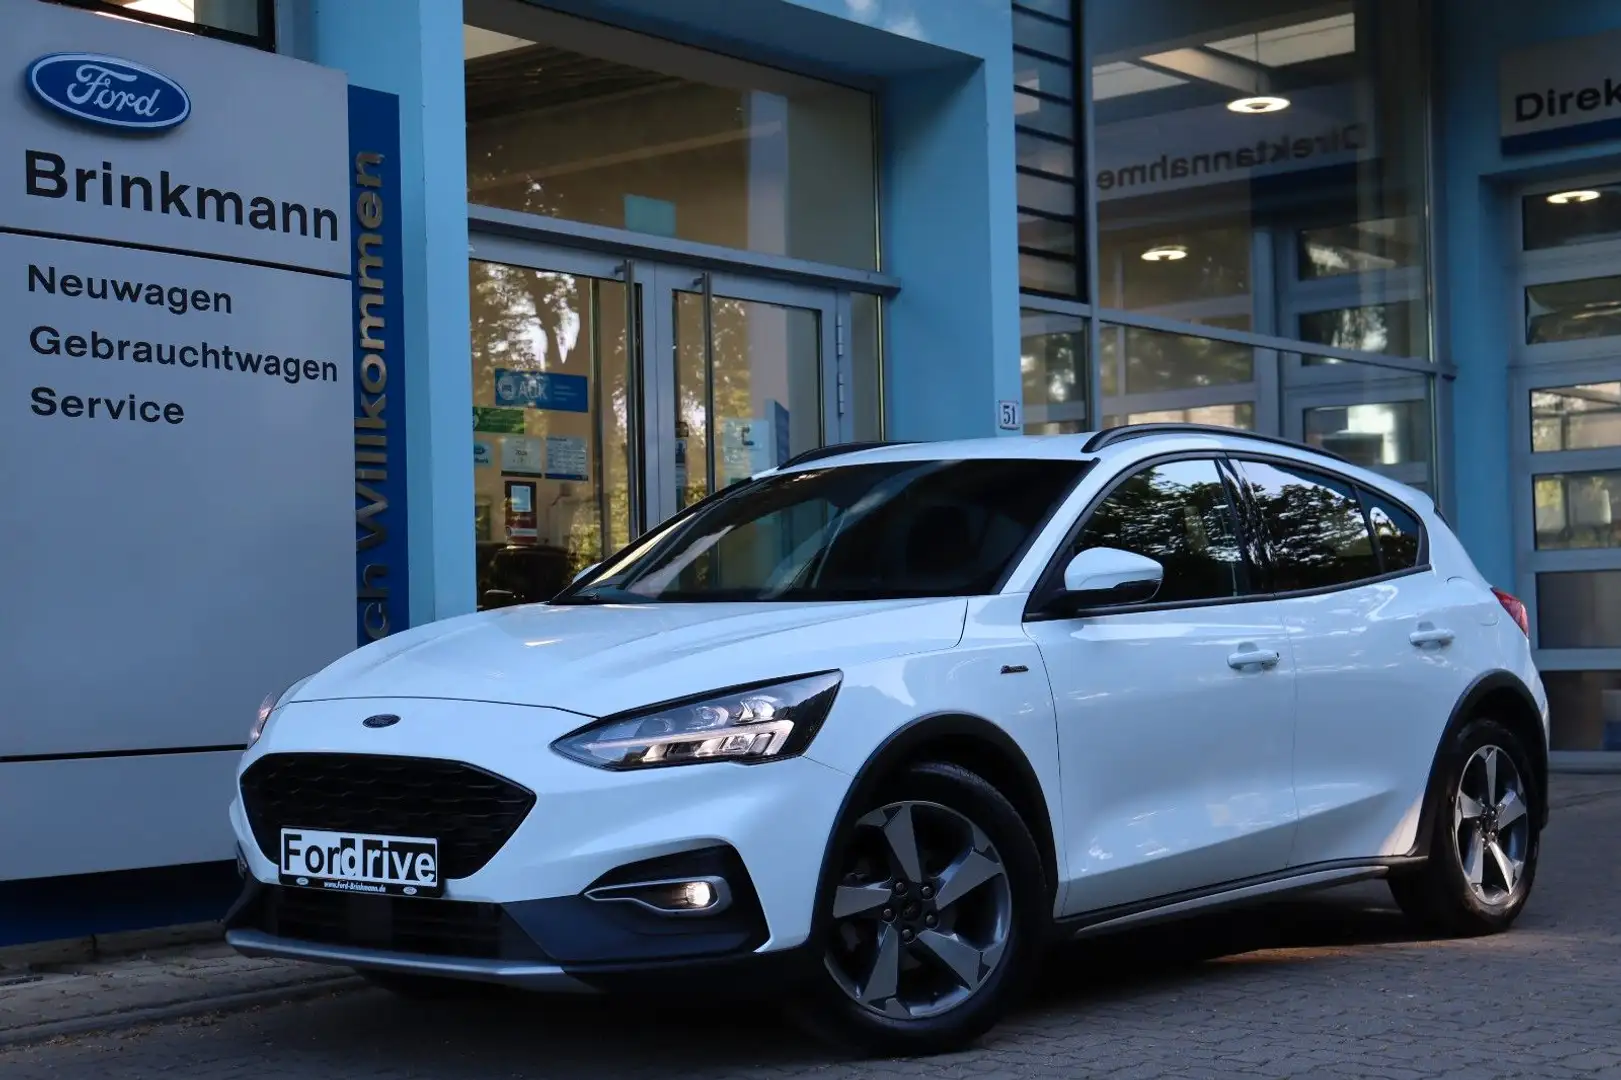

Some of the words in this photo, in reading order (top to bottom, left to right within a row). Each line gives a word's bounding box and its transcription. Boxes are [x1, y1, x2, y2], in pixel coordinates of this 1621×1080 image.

[66, 63, 161, 117] Ford
[25, 149, 338, 241] Brinkmann
[28, 264, 232, 314] Neuwagen
[29, 326, 338, 383] Gebrauchtwagen
[354, 150, 388, 553] Willkommen
[30, 386, 185, 424] Service
[1003, 404, 1016, 425] 51
[283, 832, 436, 882] Fordrive
